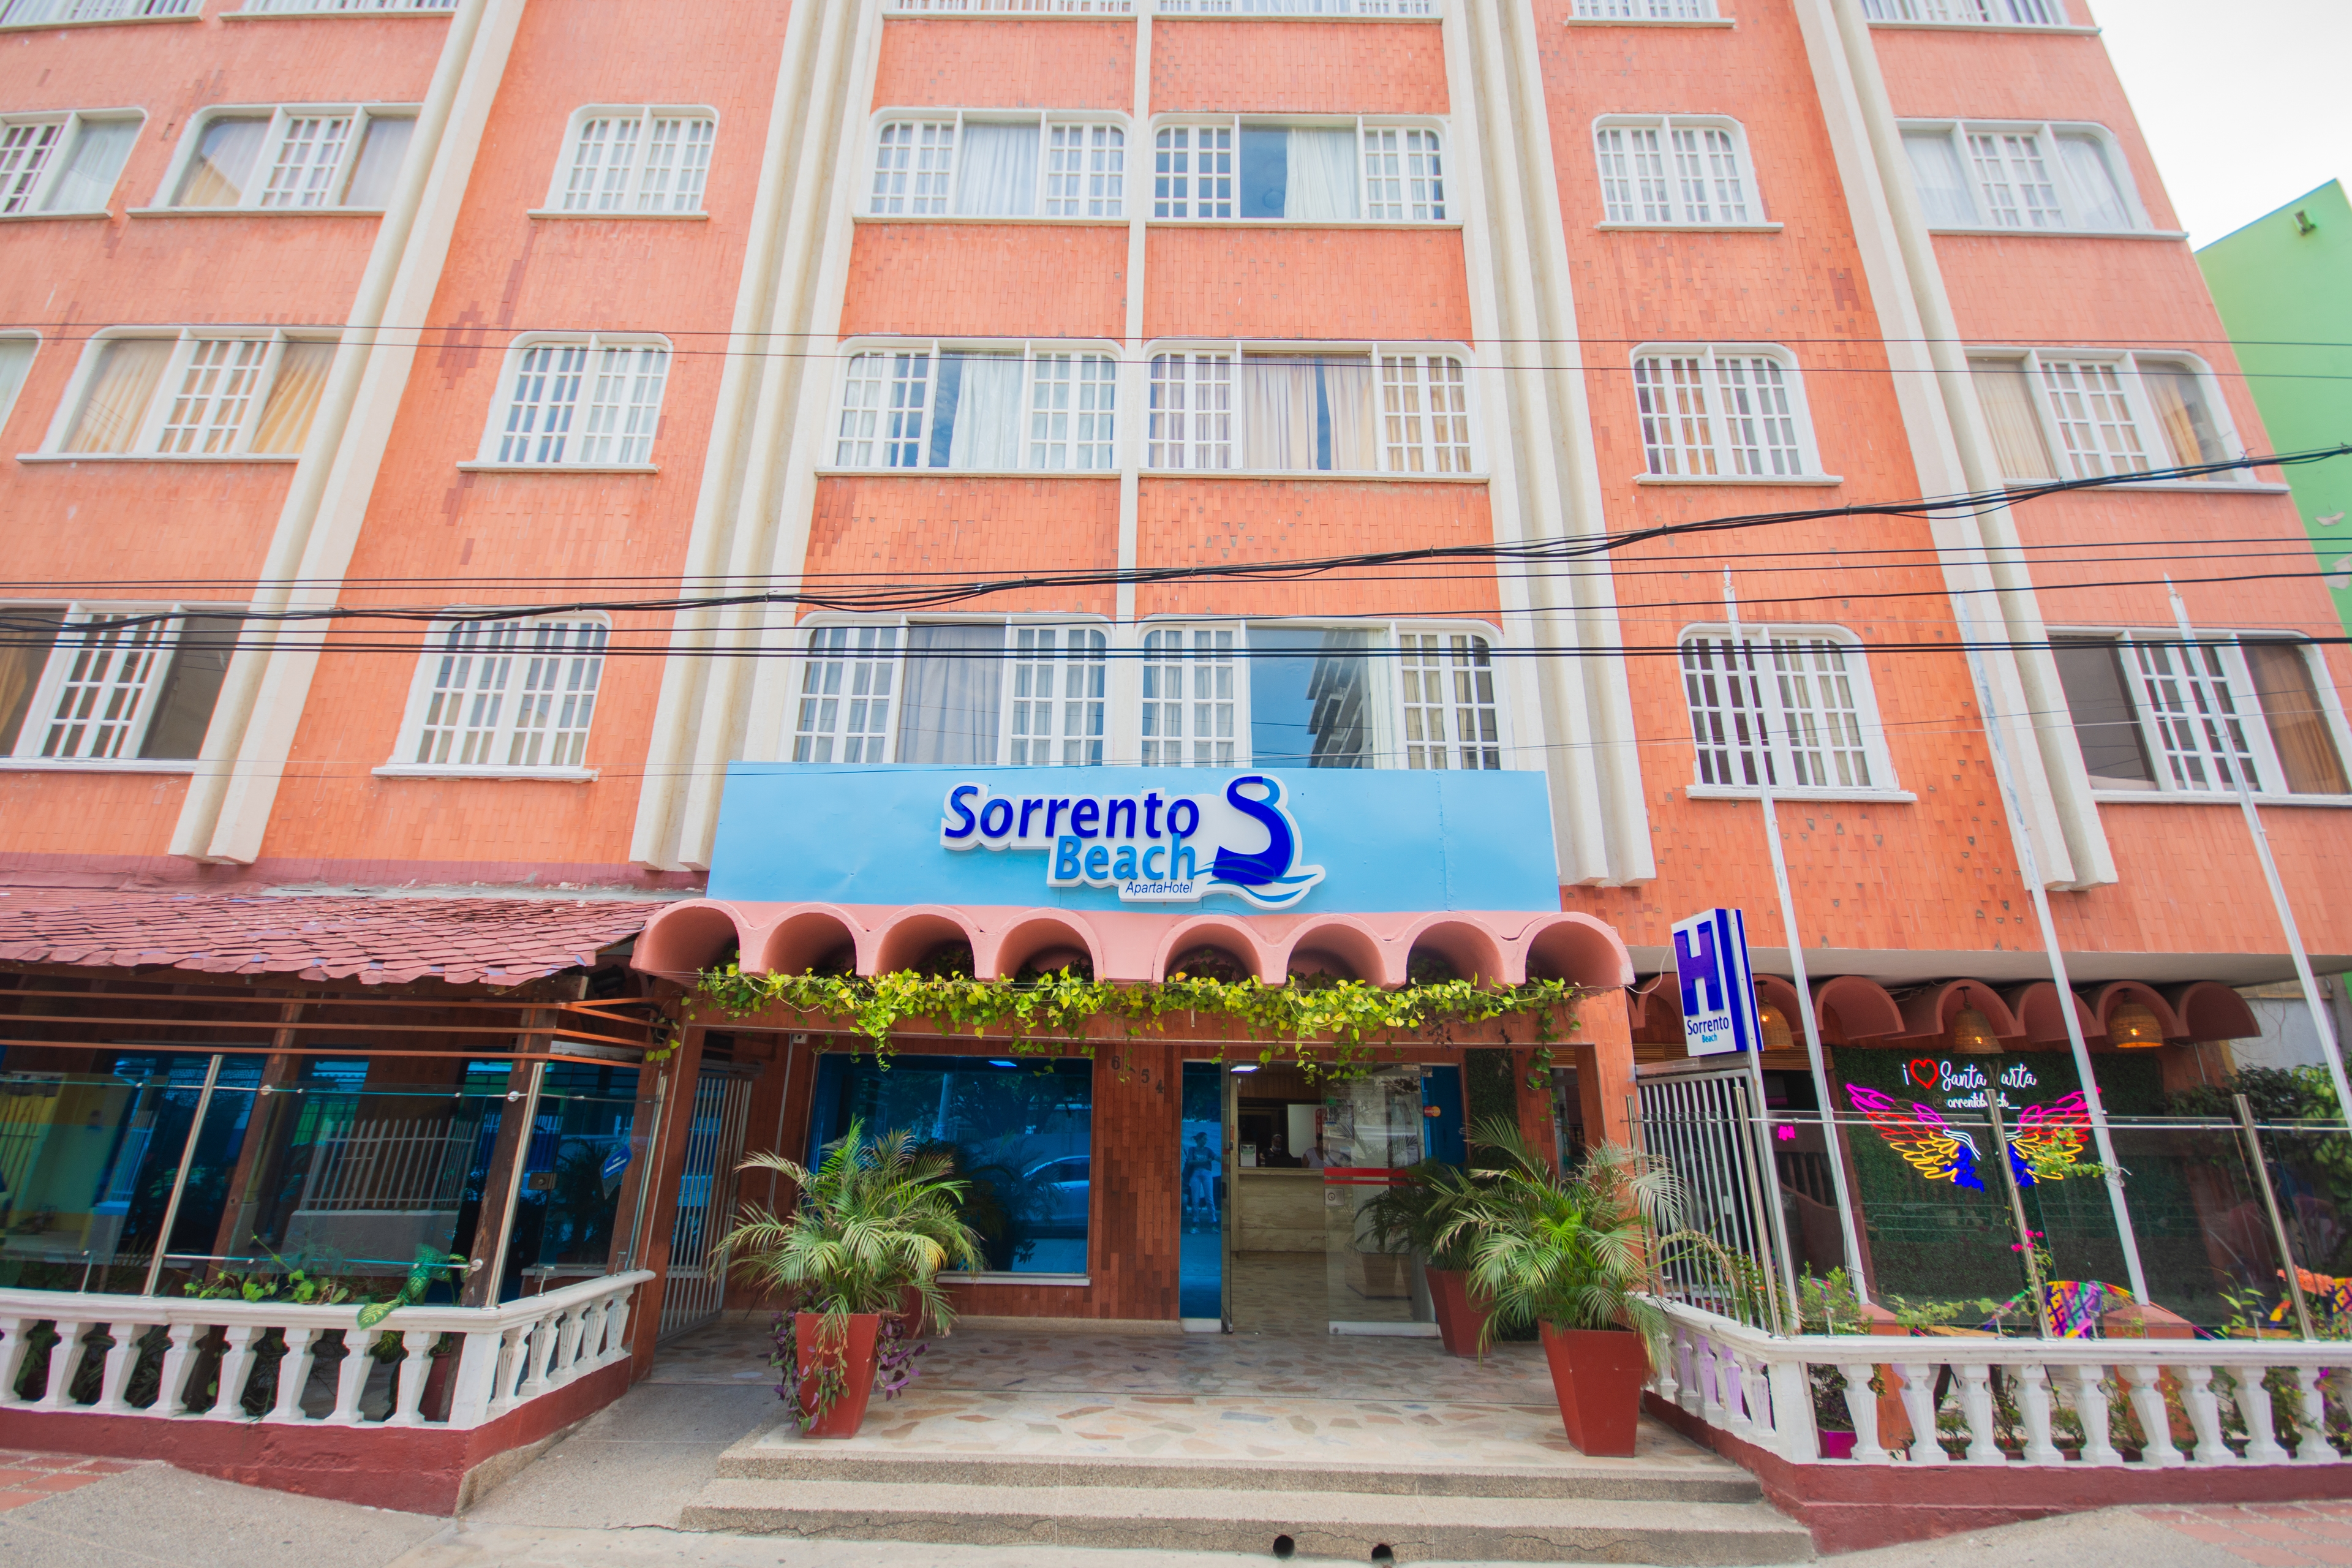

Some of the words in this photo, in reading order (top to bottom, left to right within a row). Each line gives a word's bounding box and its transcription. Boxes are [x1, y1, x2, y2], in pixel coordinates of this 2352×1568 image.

[944, 785, 1200, 839] Sorrento
[1054, 833, 1196, 881] Beach
[1125, 881, 1193, 895] ApartaHotel
[1673, 921, 1724, 1016] H
[1687, 1017, 1730, 1035] Sorrento
[1702, 1033, 1718, 1043] Beach
[1940, 1060, 1987, 1091] Santa
